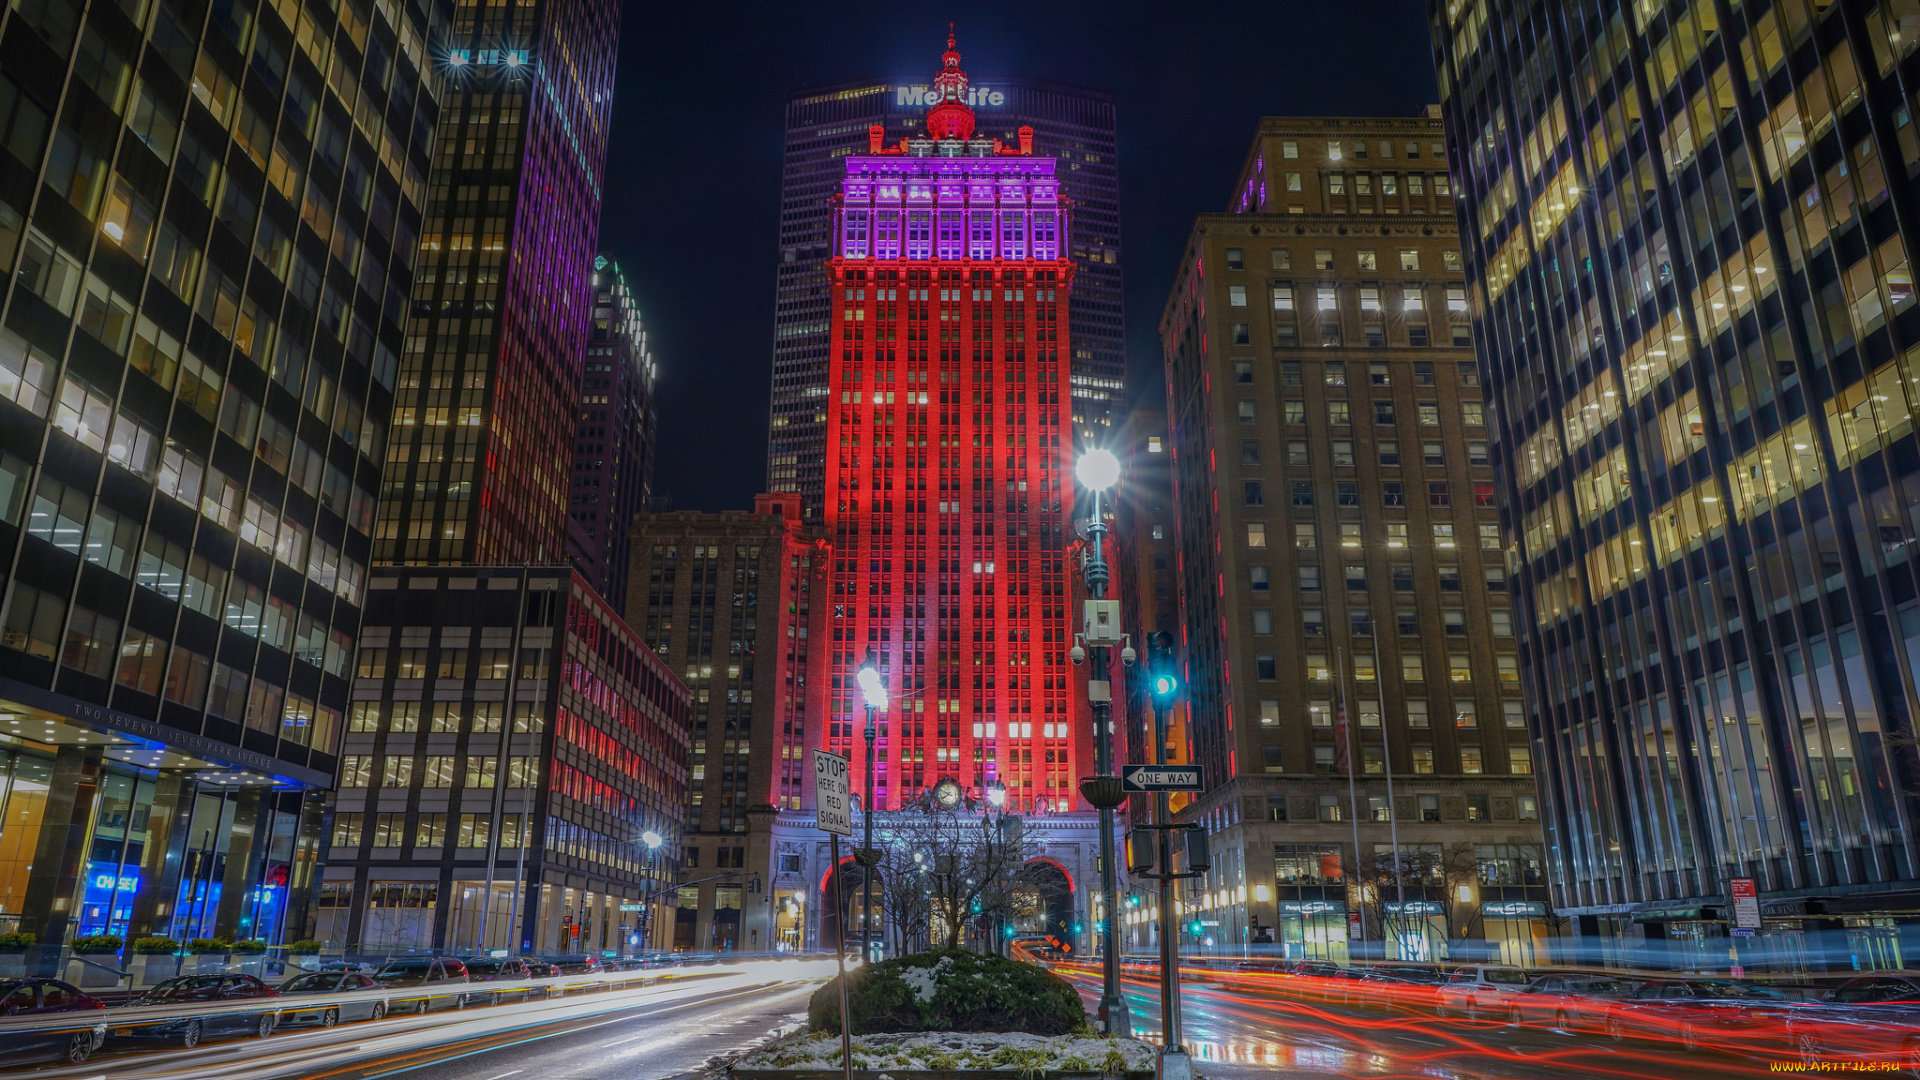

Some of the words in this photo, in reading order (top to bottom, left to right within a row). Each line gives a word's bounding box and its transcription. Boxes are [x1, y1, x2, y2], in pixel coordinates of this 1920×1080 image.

[897, 86, 1004, 105] Meife
[74, 703, 101, 720] TWO
[108, 713, 163, 737] SEVENTY
[168, 731, 201, 748] SEVEN
[206, 742, 231, 757] PARK
[236, 751, 271, 769] AVENUE
[816, 756, 846, 778] STOP
[818, 777, 835, 792] HERE
[838, 783, 847, 795] ON
[1137, 773, 1161, 784] ONE
[1167, 773, 1192, 784] WAY
[826, 795, 841, 809] RED
[820, 811, 848, 828] SIGNAL
